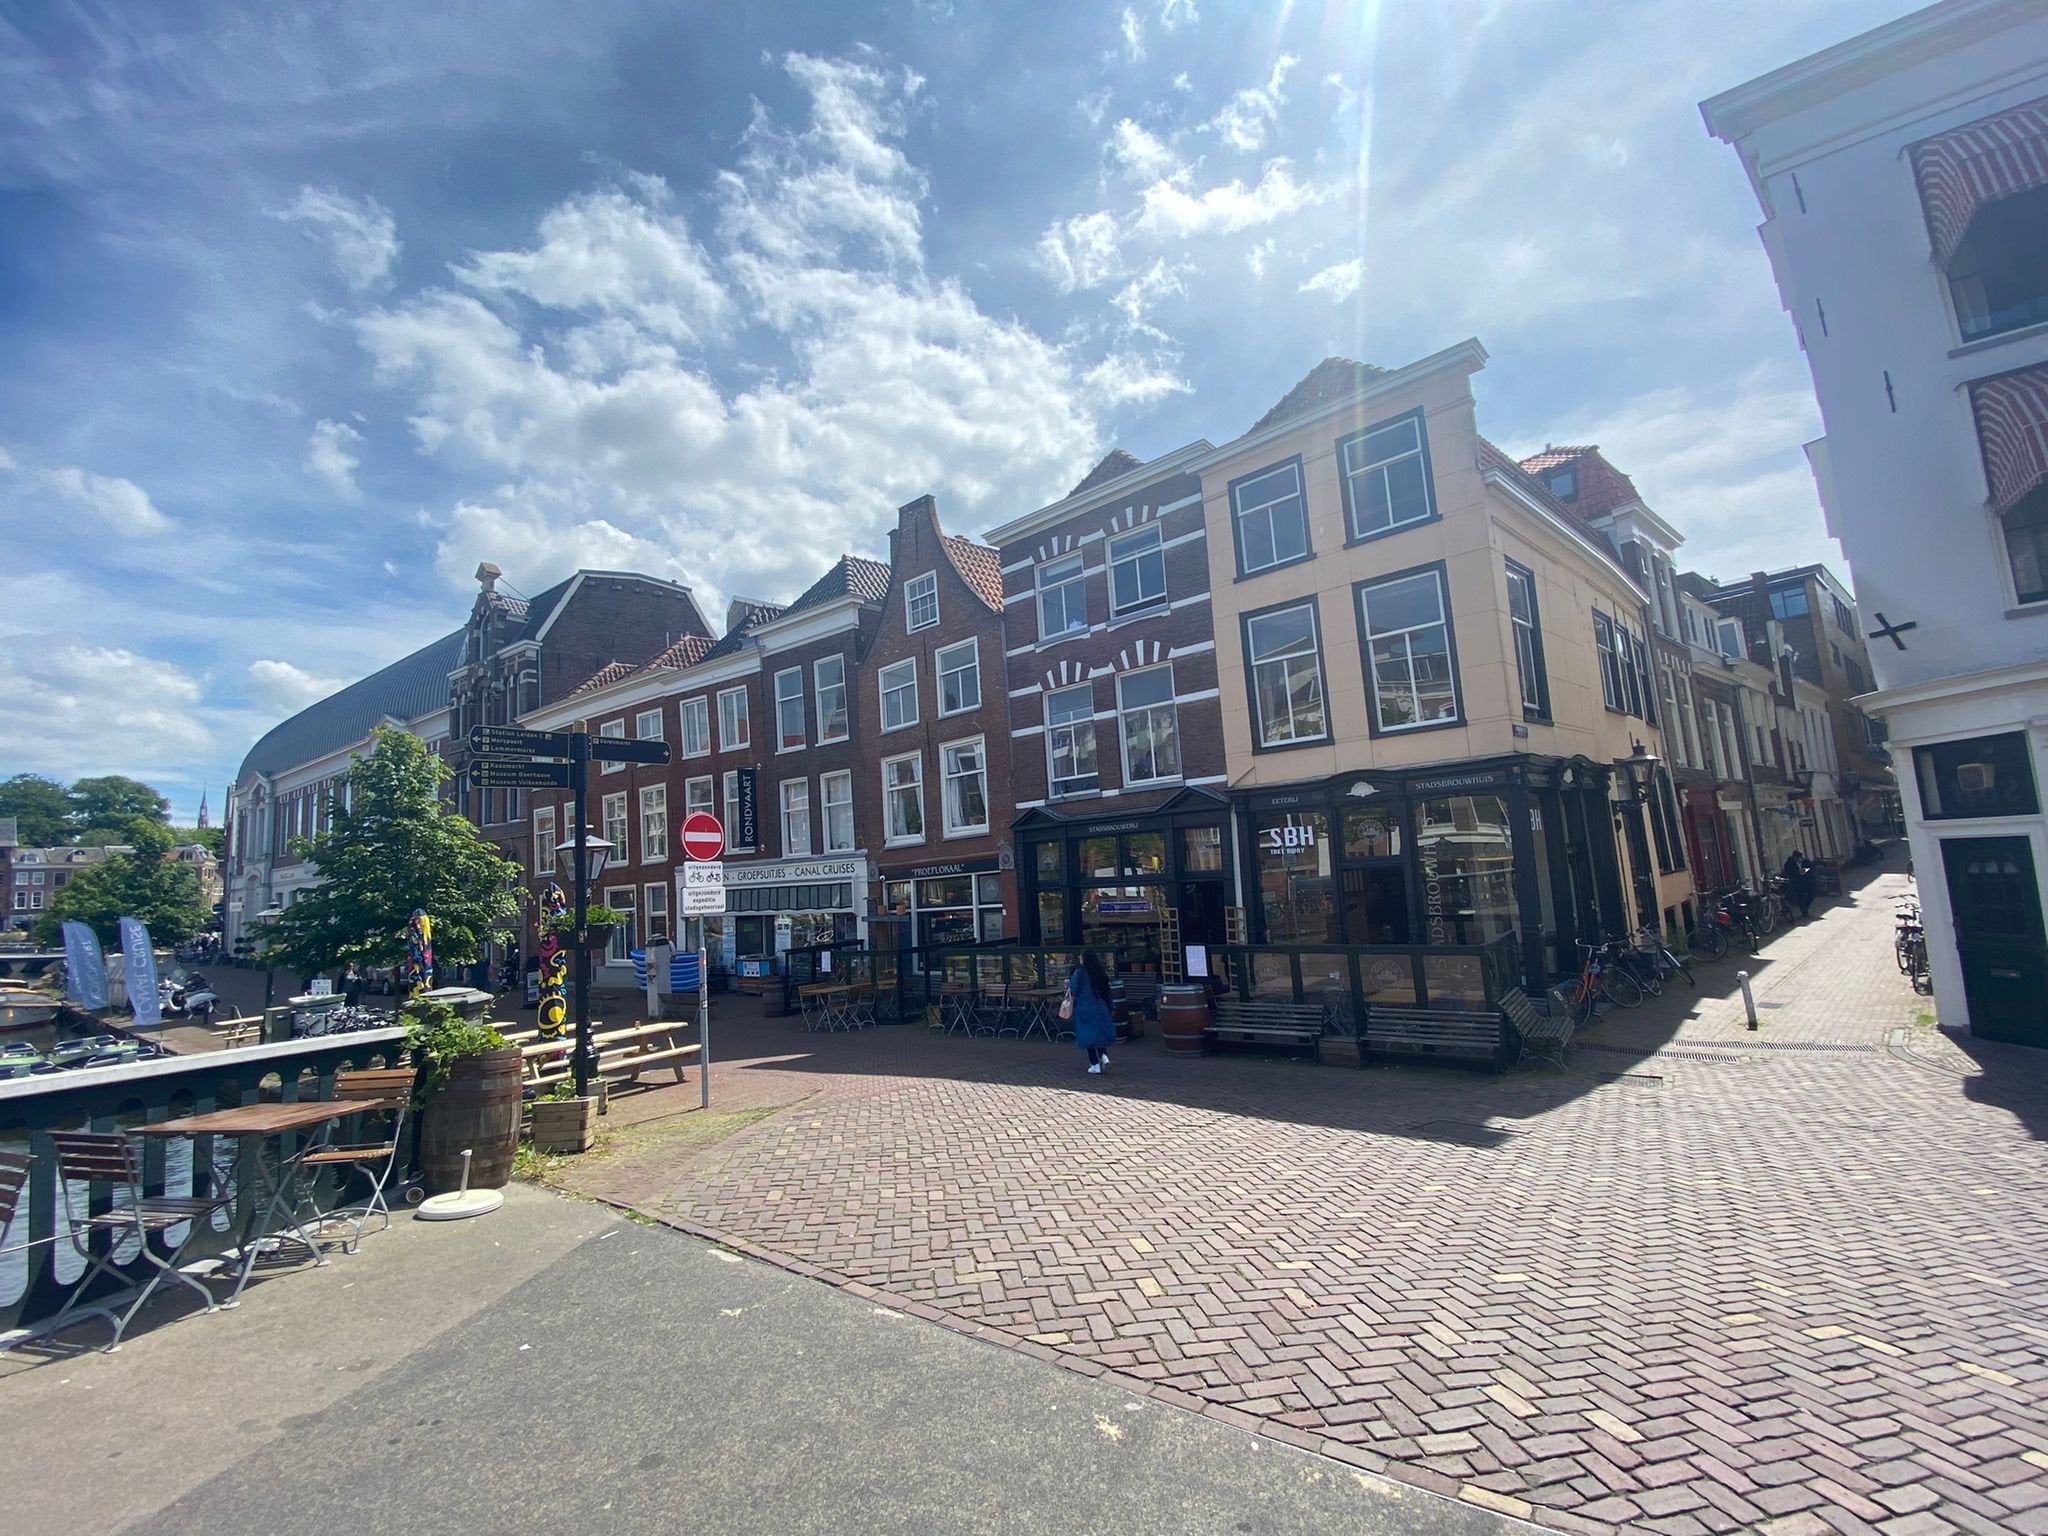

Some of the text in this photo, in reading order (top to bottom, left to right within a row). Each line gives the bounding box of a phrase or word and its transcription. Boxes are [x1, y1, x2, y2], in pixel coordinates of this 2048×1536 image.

[1415, 775, 1494, 790] STADSBROUWHUIS
[742, 774, 754, 842] RONDVAART
[1269, 825, 1315, 848] SBH
[737, 868, 786, 881] GROEPSUITJES
[794, 866, 821, 877] CANAL
[822, 862, 856, 875] CRUISES
